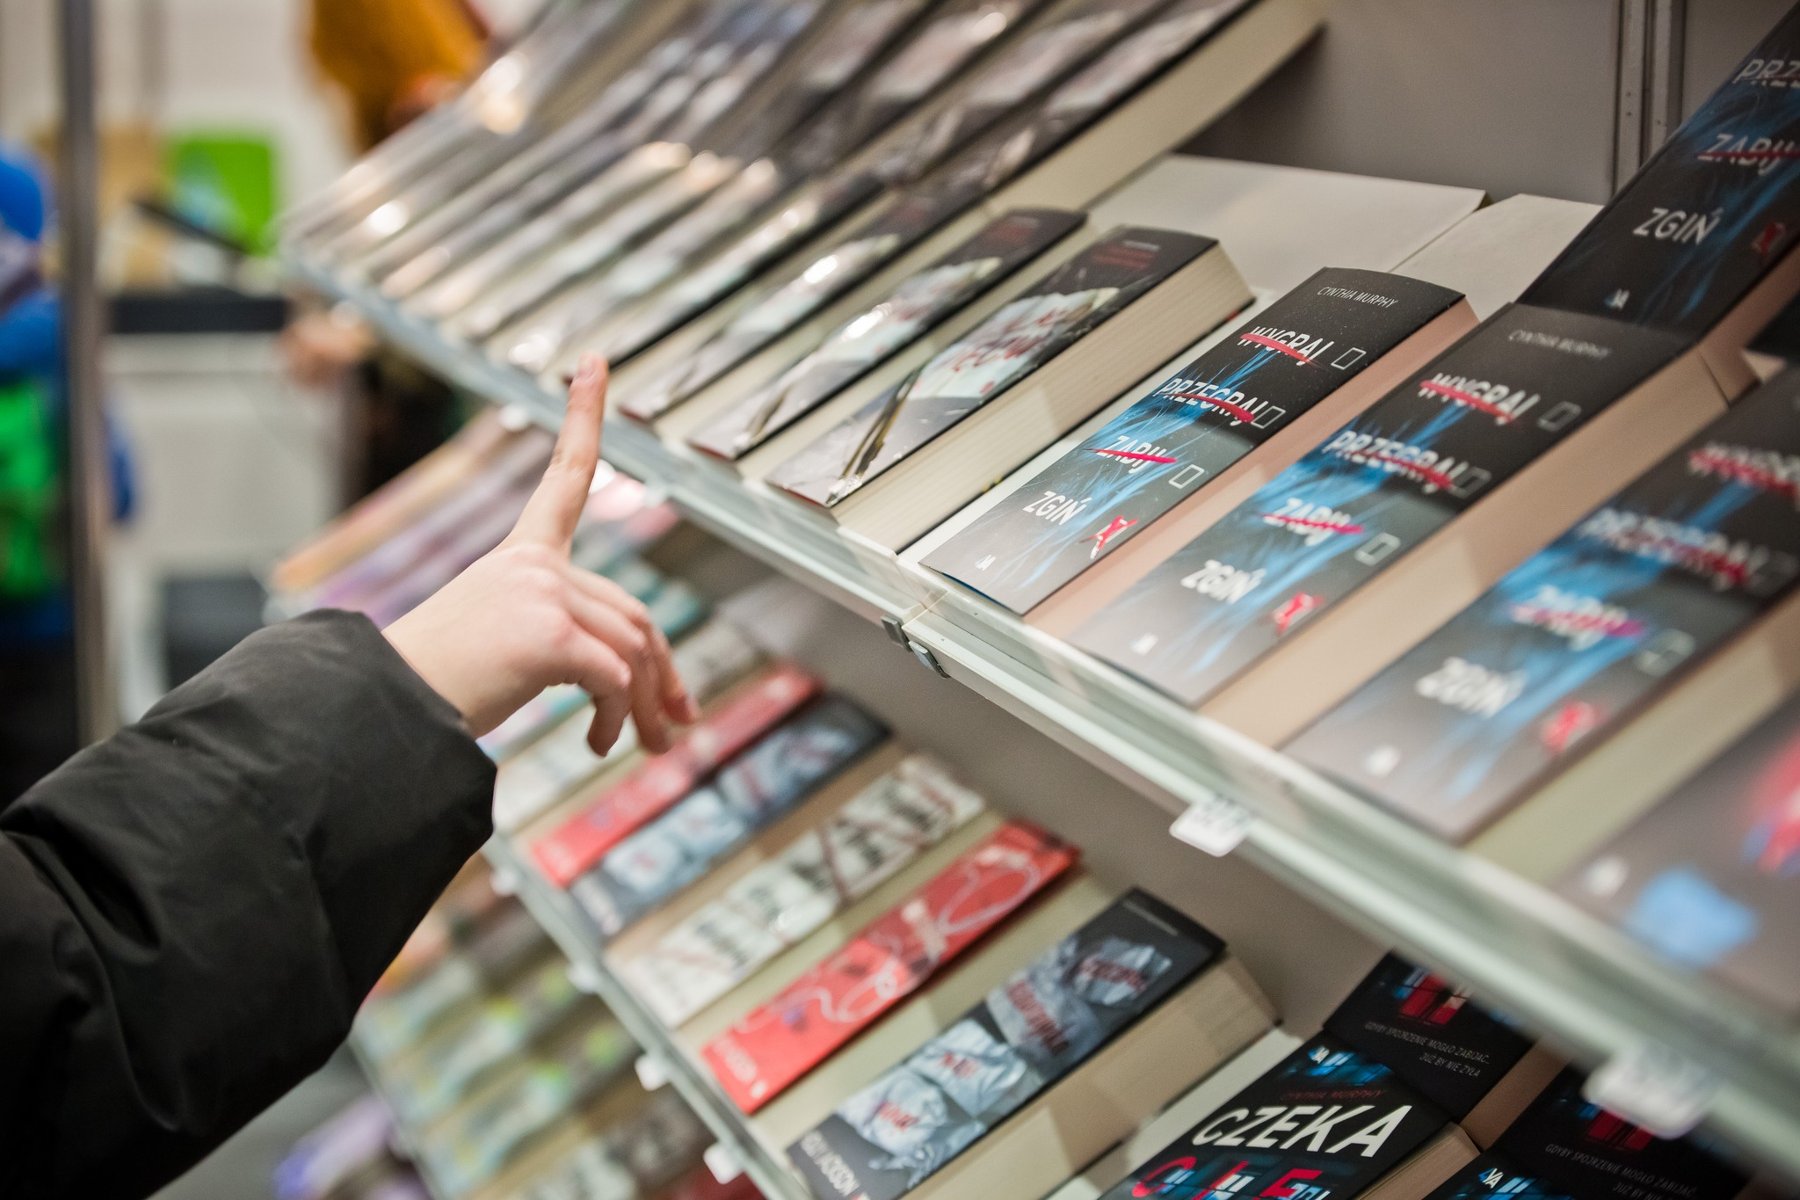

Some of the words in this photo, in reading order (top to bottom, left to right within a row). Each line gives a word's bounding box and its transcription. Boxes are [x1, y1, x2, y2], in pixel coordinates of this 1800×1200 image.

[1317, 286, 1358, 300] CYNTHIA
[1354, 292, 1398, 308] MURPHY
[1237, 326, 1334, 366] WYGRAJ
[1152, 378, 1268, 426] PRZEGRAJ
[1022, 490, 1093, 525] ZGIŃ
[1192, 1105, 1413, 1158] CZEKA
